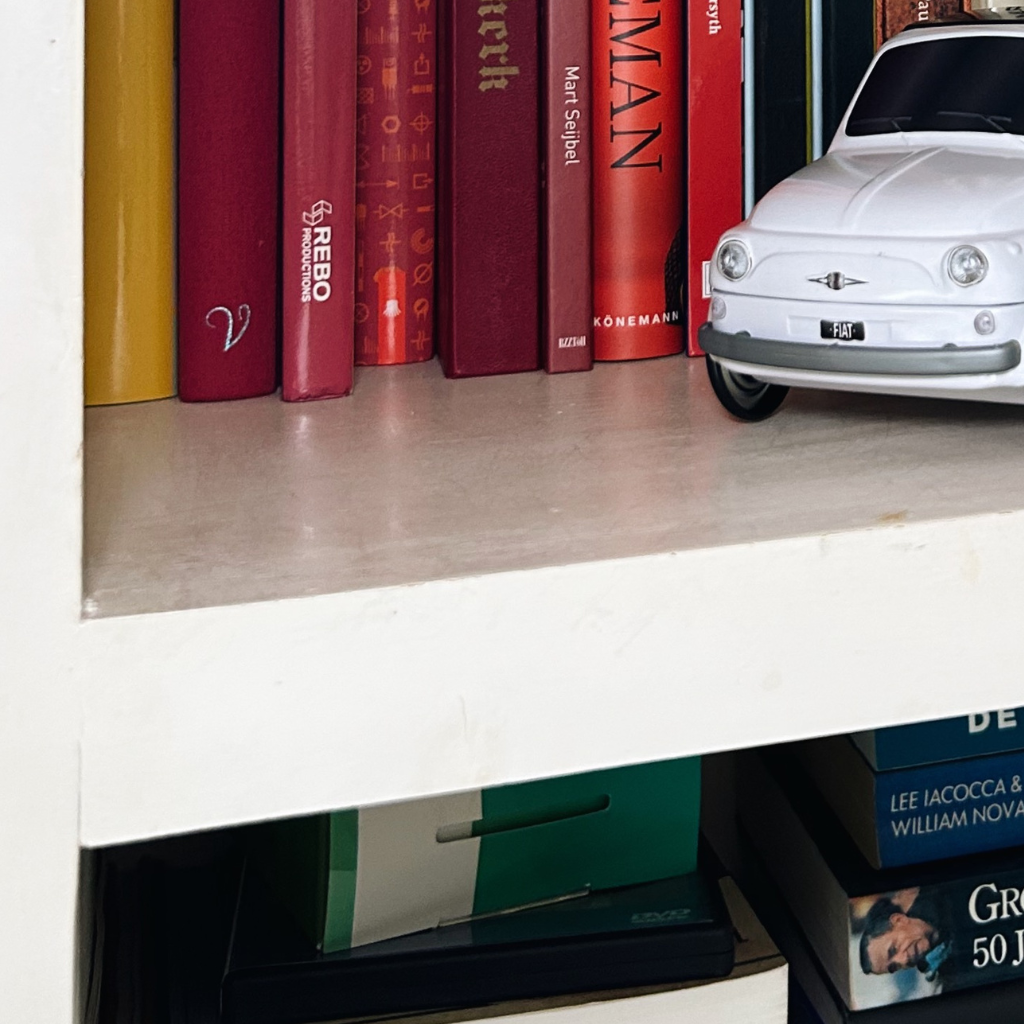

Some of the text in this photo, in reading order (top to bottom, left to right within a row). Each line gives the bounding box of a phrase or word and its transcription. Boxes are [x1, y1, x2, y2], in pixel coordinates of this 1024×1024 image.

[561, 65, 581, 165] Mart Seijbel
[301, 227, 312, 303] PRODUCTIONS
[313, 227, 332, 302] REBO
[593, 311, 679, 327] KÖNEMANN
[833, 322, 853, 338] FIAT
[968, 707, 1018, 734] DE
[890, 775, 1023, 813] LEE IACOCCA &
[891, 807, 968, 837] WILLIAM
[972, 933, 1008, 968] 50
